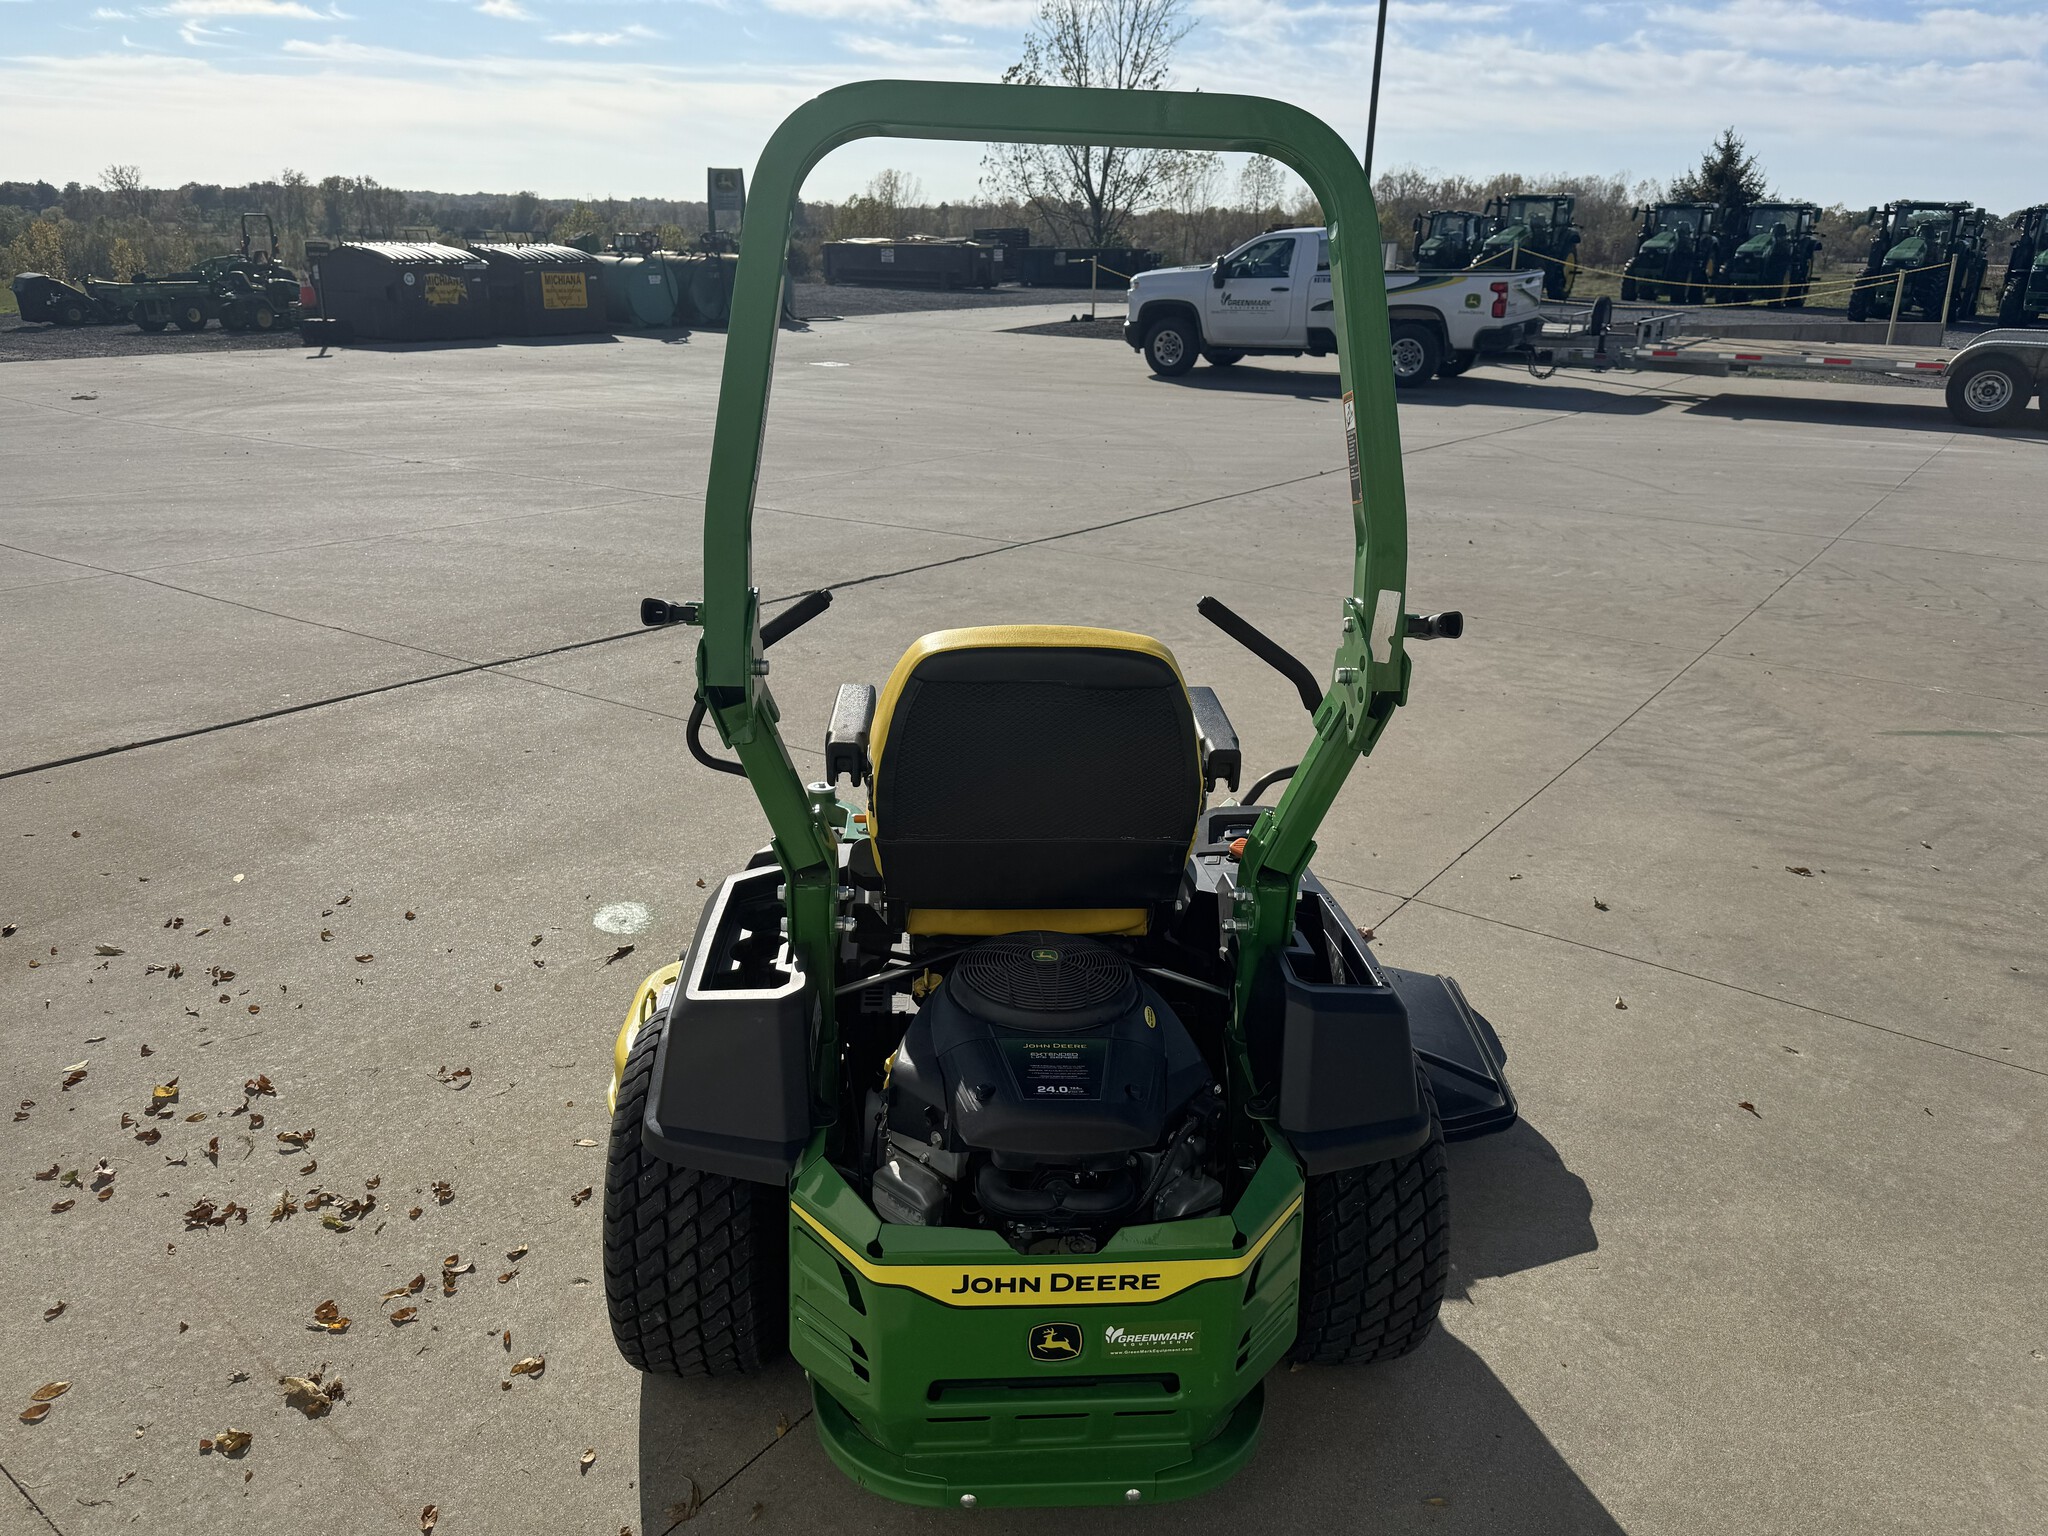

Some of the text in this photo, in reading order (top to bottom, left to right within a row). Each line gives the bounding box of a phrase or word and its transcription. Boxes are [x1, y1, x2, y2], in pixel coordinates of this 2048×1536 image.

[544, 274, 582, 286] MICHIANA
[1227, 299, 1272, 307] GREENMARK
[951, 1273, 1161, 1294] JOHN DEERE
[1118, 1331, 1196, 1343] GREENMARK
